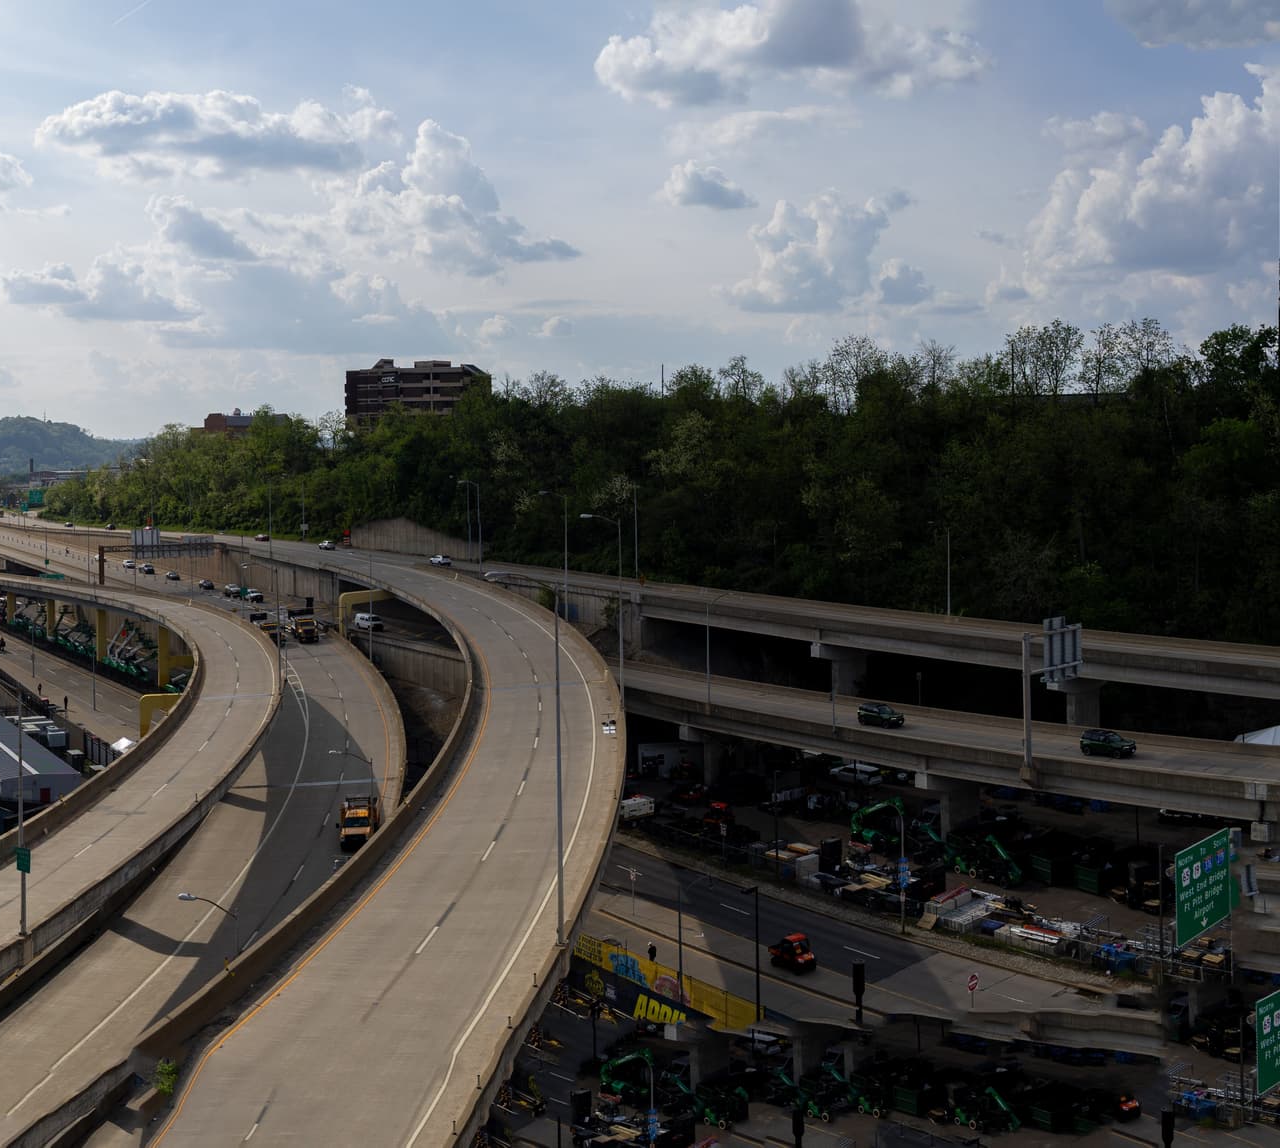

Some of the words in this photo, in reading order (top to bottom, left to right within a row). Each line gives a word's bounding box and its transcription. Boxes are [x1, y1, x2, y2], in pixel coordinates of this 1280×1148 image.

[1180, 887, 1195, 901] West
[1197, 881, 1207, 891] End
[1209, 868, 1227, 885] Bridge
[1184, 902, 1190, 912] Ft
[1193, 896, 1203, 908] Pitt
[1205, 884, 1223, 900] Bridge
[1194, 901, 1215, 920] Airport
[1260, 1035, 1275, 1049] West
